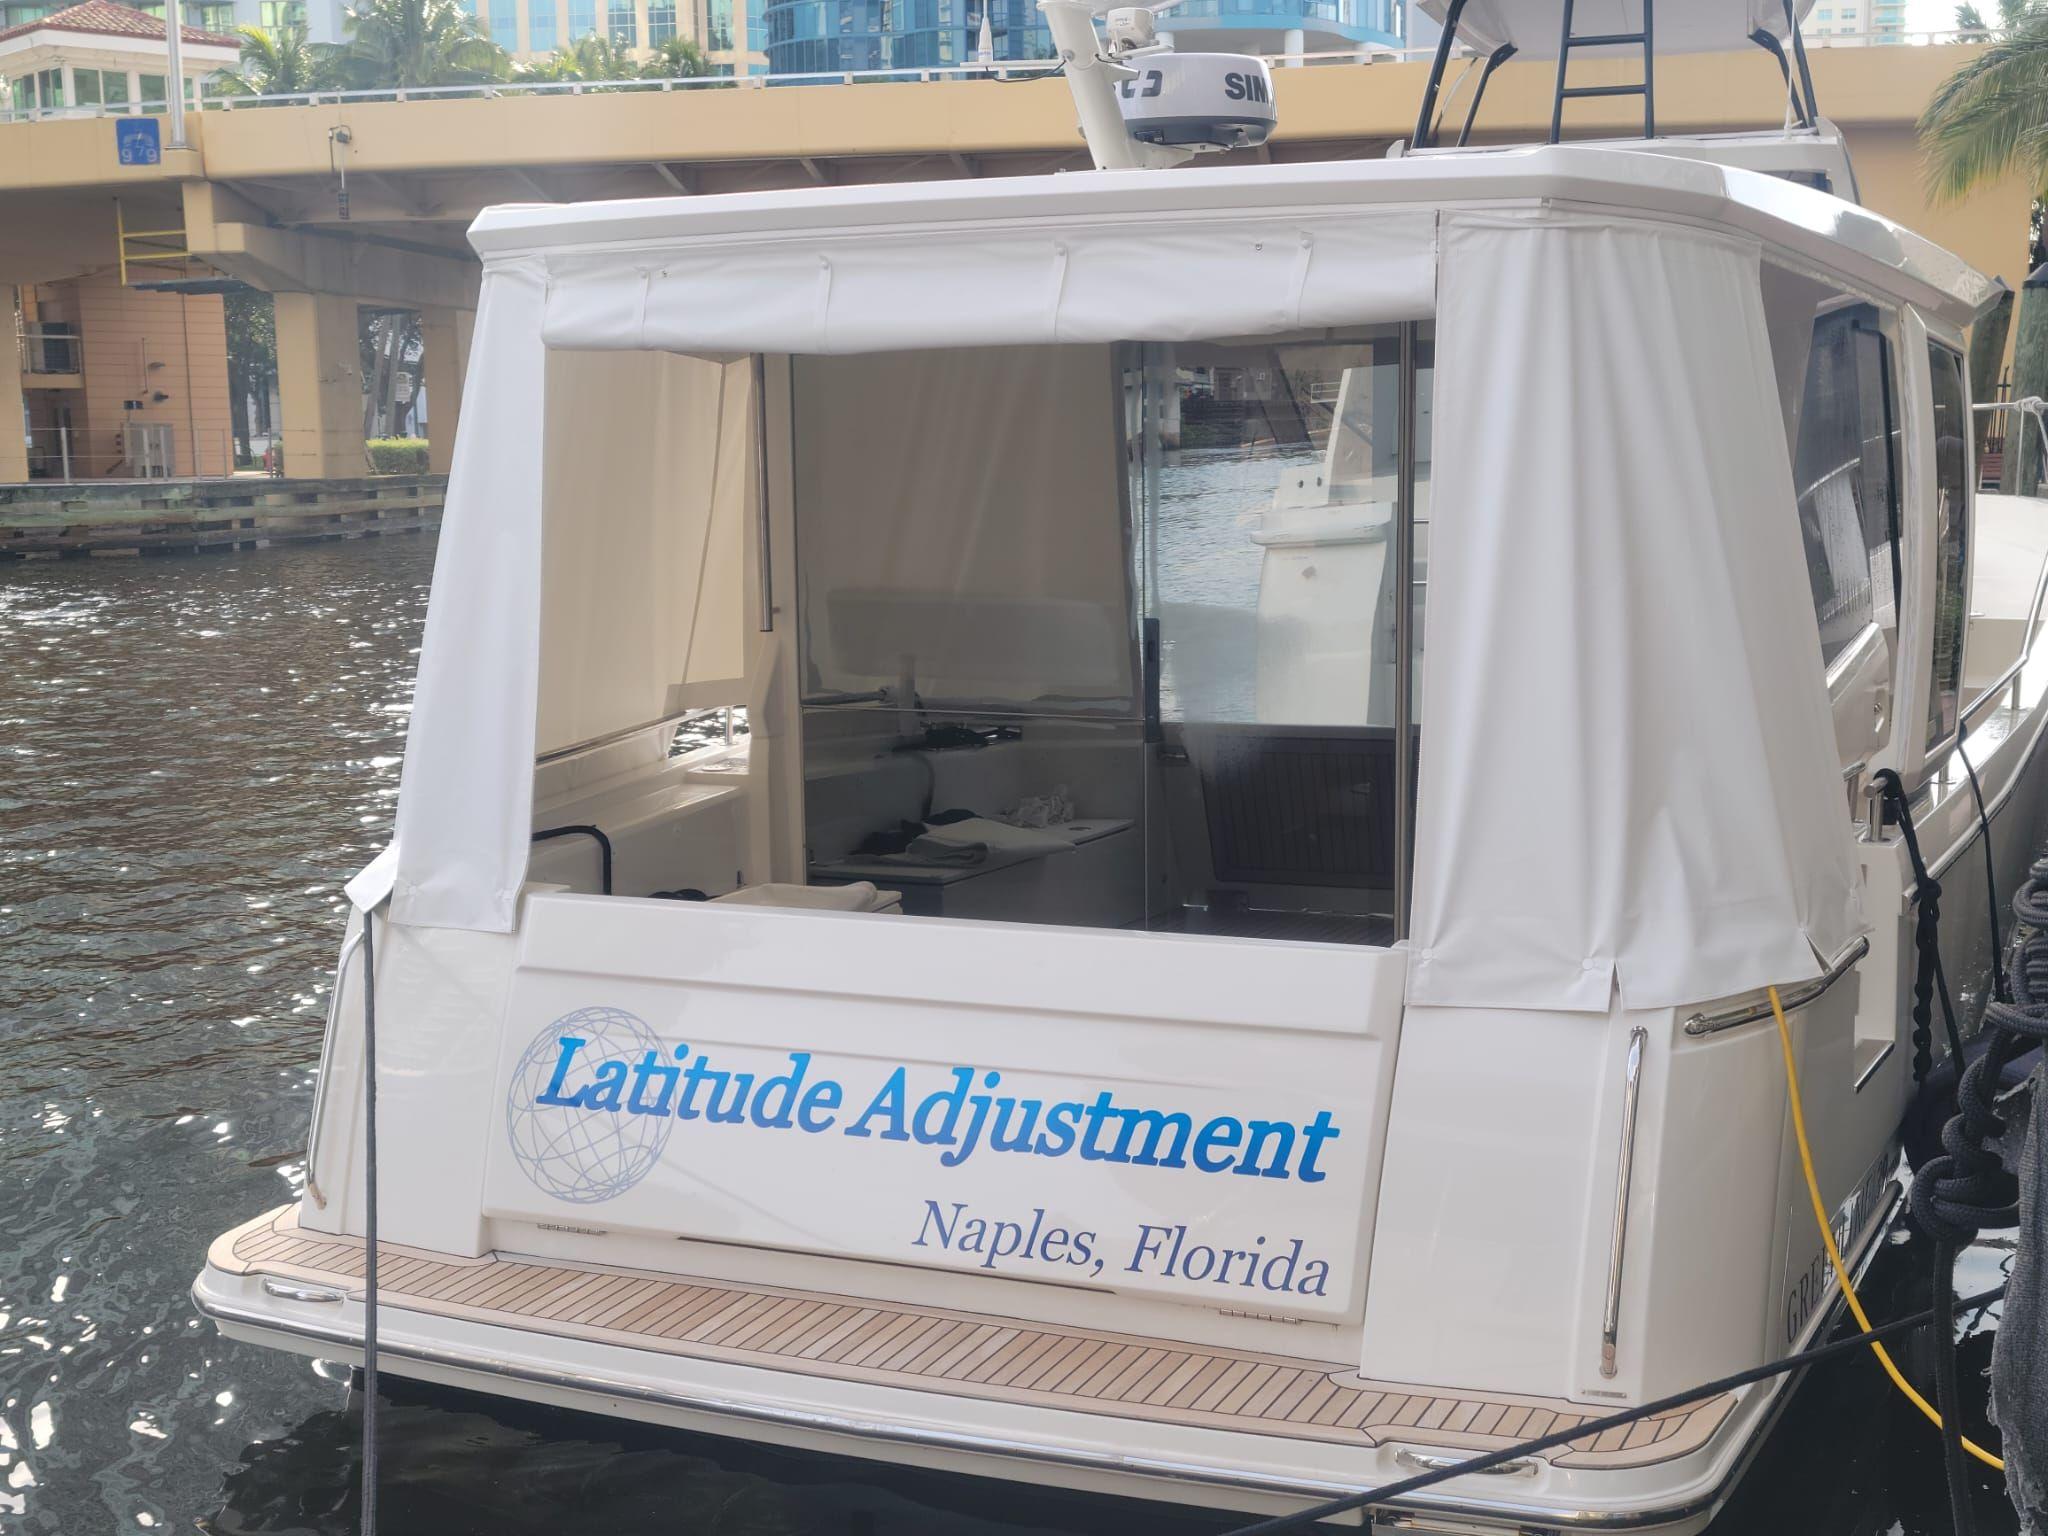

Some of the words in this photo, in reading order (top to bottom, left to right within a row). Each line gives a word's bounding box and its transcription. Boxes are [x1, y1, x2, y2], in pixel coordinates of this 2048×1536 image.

[1225, 73, 1268, 104] SIM
[536, 1036, 843, 1132] Latitude
[845, 1066, 1340, 1183] Adjustment
[912, 1200, 1104, 1277] Naples,
[1125, 1225, 1328, 1297] Florida
